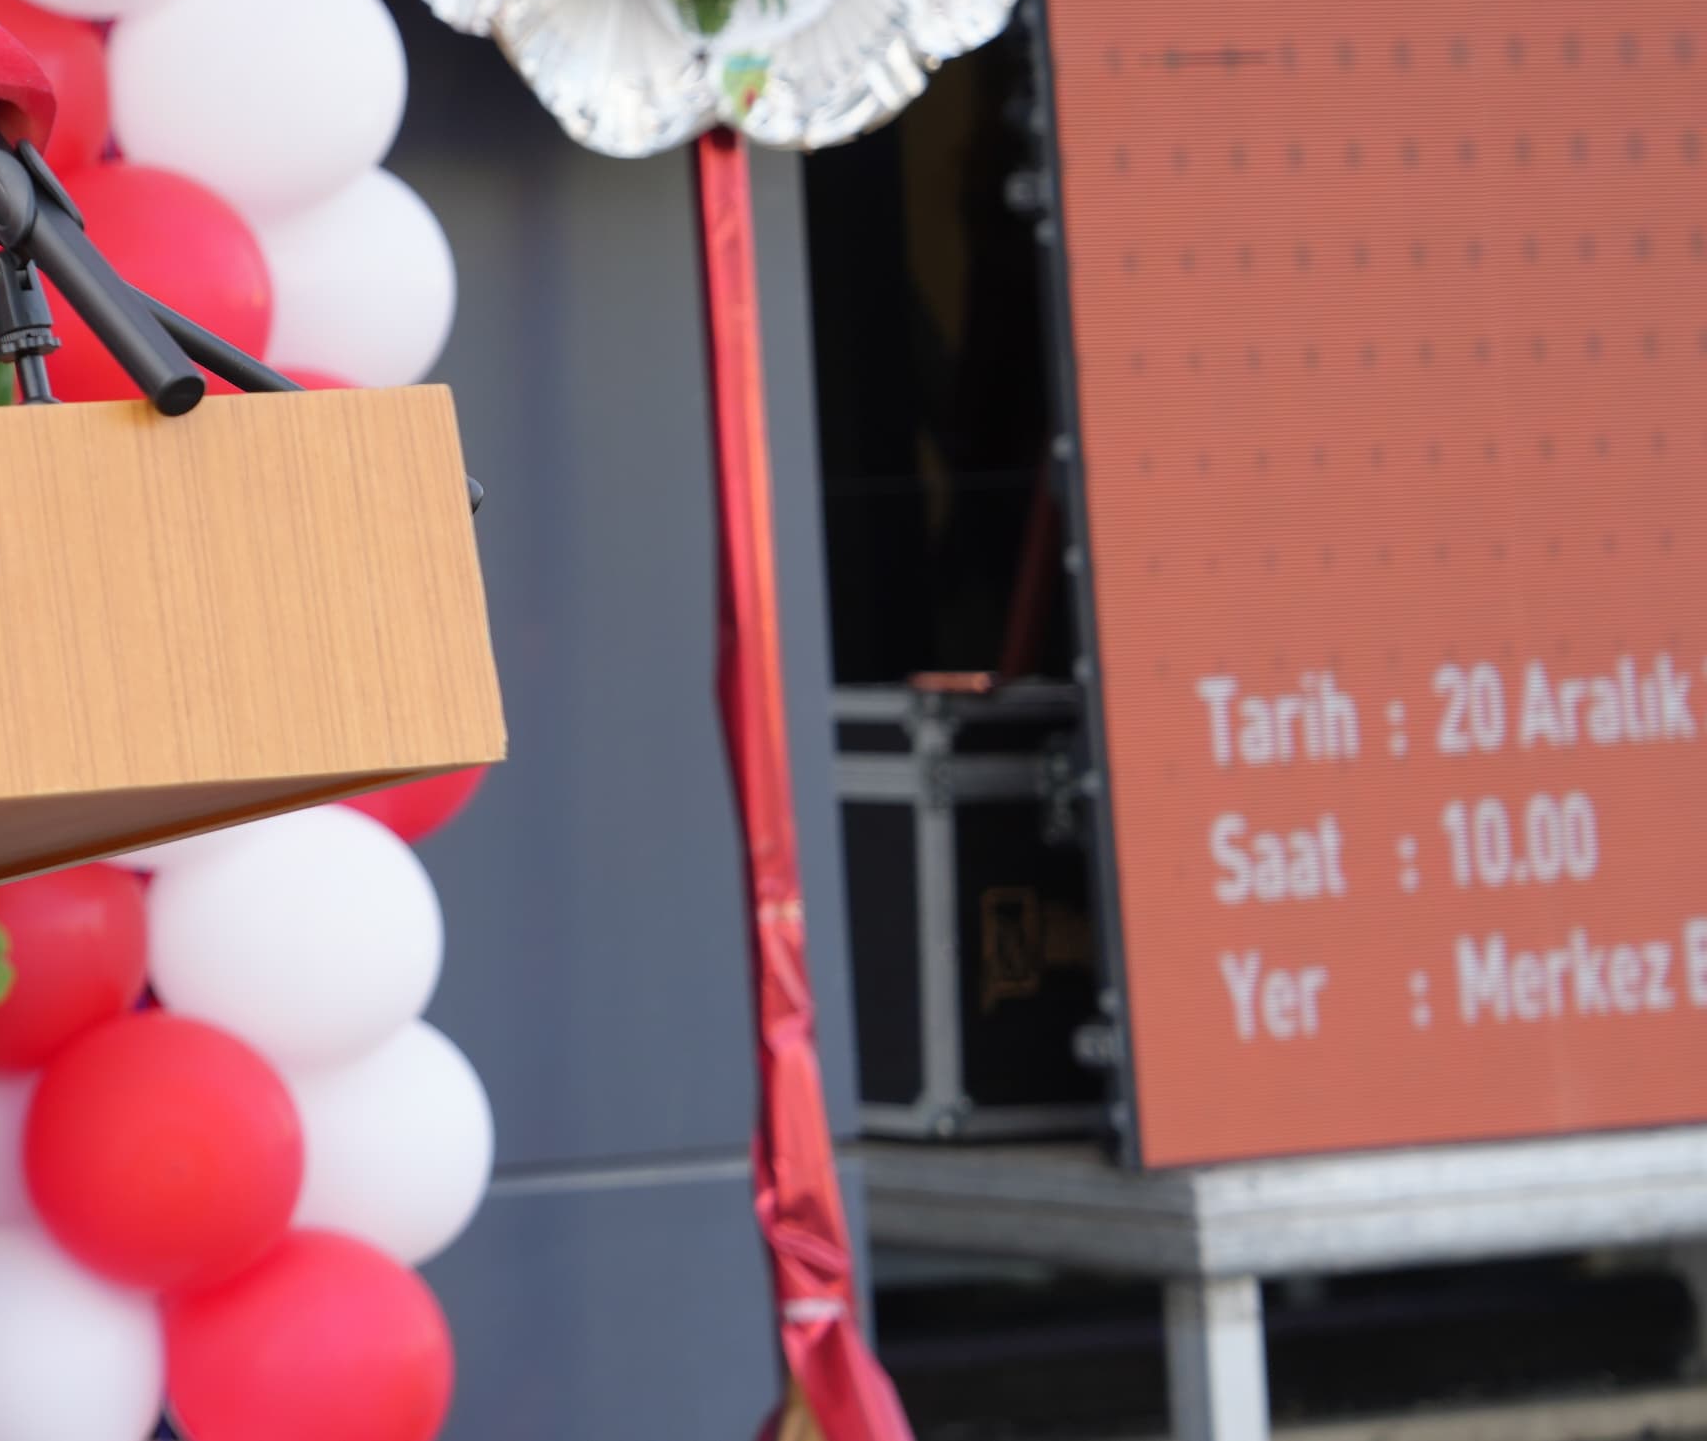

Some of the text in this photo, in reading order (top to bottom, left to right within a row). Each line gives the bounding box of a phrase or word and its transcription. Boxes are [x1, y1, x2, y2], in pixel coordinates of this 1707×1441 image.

[1196, 670, 1362, 766] Tarih
[1433, 661, 1507, 754] 20
[1518, 652, 1698, 748] Aralık
[1209, 812, 1348, 905] Saat
[1441, 790, 1600, 888] 10.00
[1219, 950, 1329, 1040] Yer
[1455, 927, 1677, 1024] Merkez
